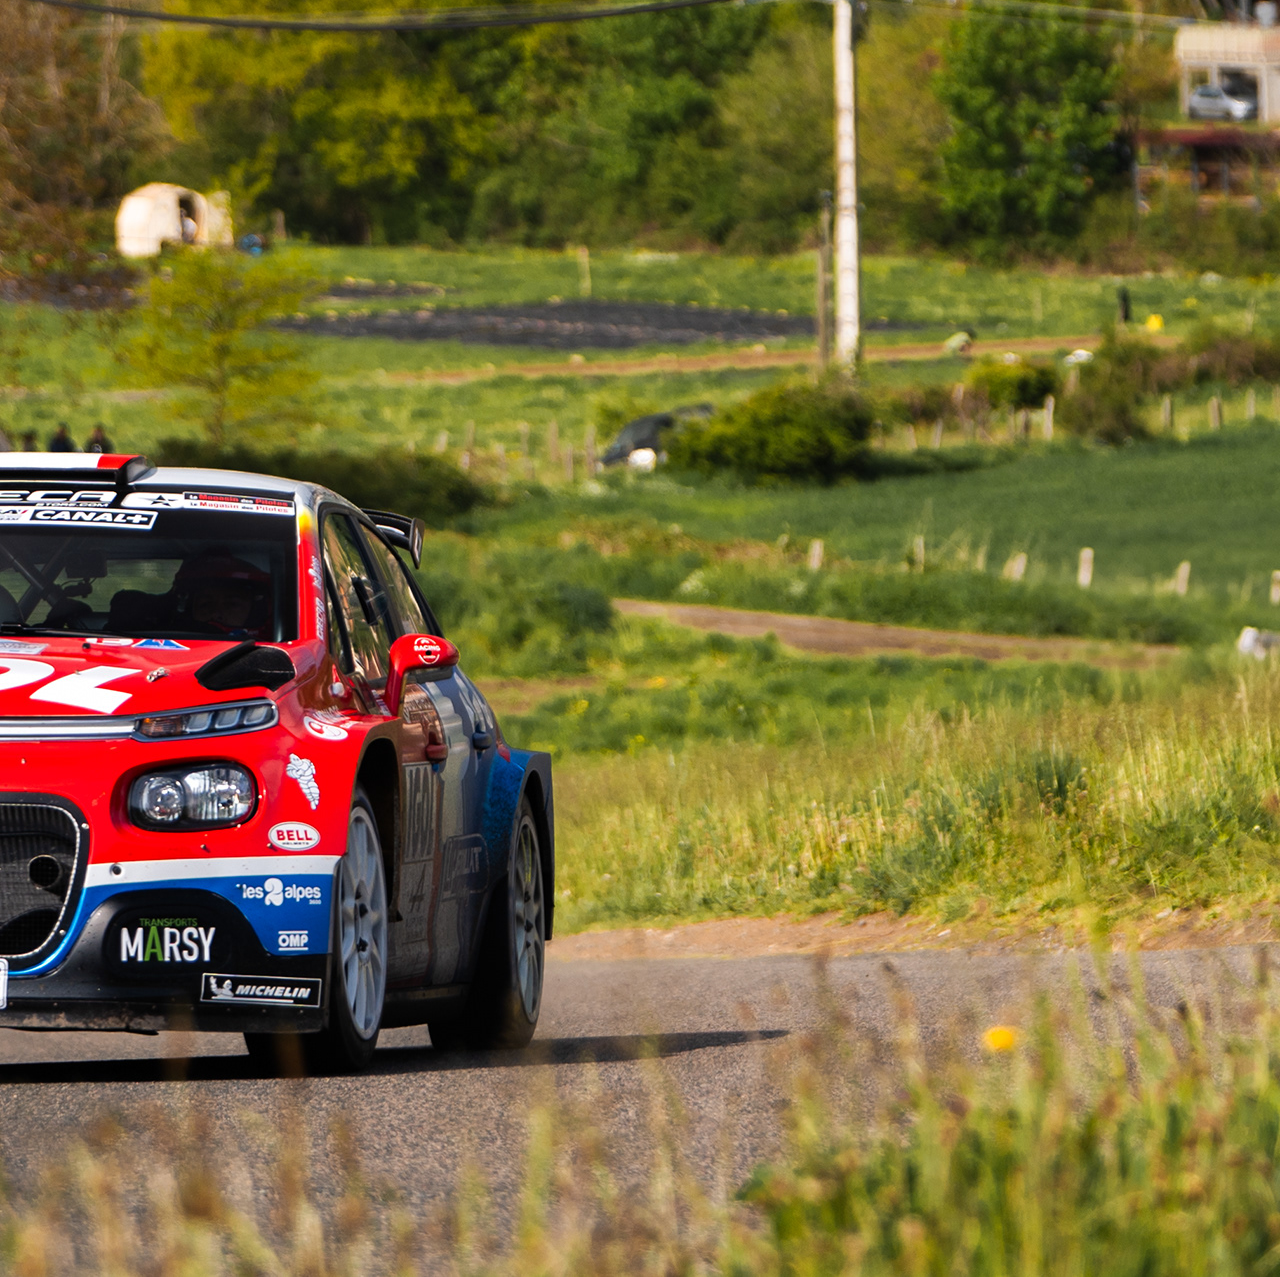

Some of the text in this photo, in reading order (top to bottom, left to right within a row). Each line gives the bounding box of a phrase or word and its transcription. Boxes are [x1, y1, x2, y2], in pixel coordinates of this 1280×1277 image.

[199, 493, 239, 503] Magasin
[255, 498, 289, 507] Pilotes
[199, 501, 239, 509] Magasin
[256, 505, 289, 513] Pilotes
[35, 509, 149, 524] CANAL+
[413, 644, 441, 652] RACING
[276, 829, 313, 841] BELL
[242, 877, 322, 906] les 2 alpes
[139, 917, 198, 927] TRANSPORTS
[120, 925, 216, 962] MARSY
[278, 934, 309, 948] OMP
[235, 983, 312, 998] MICHELIN
